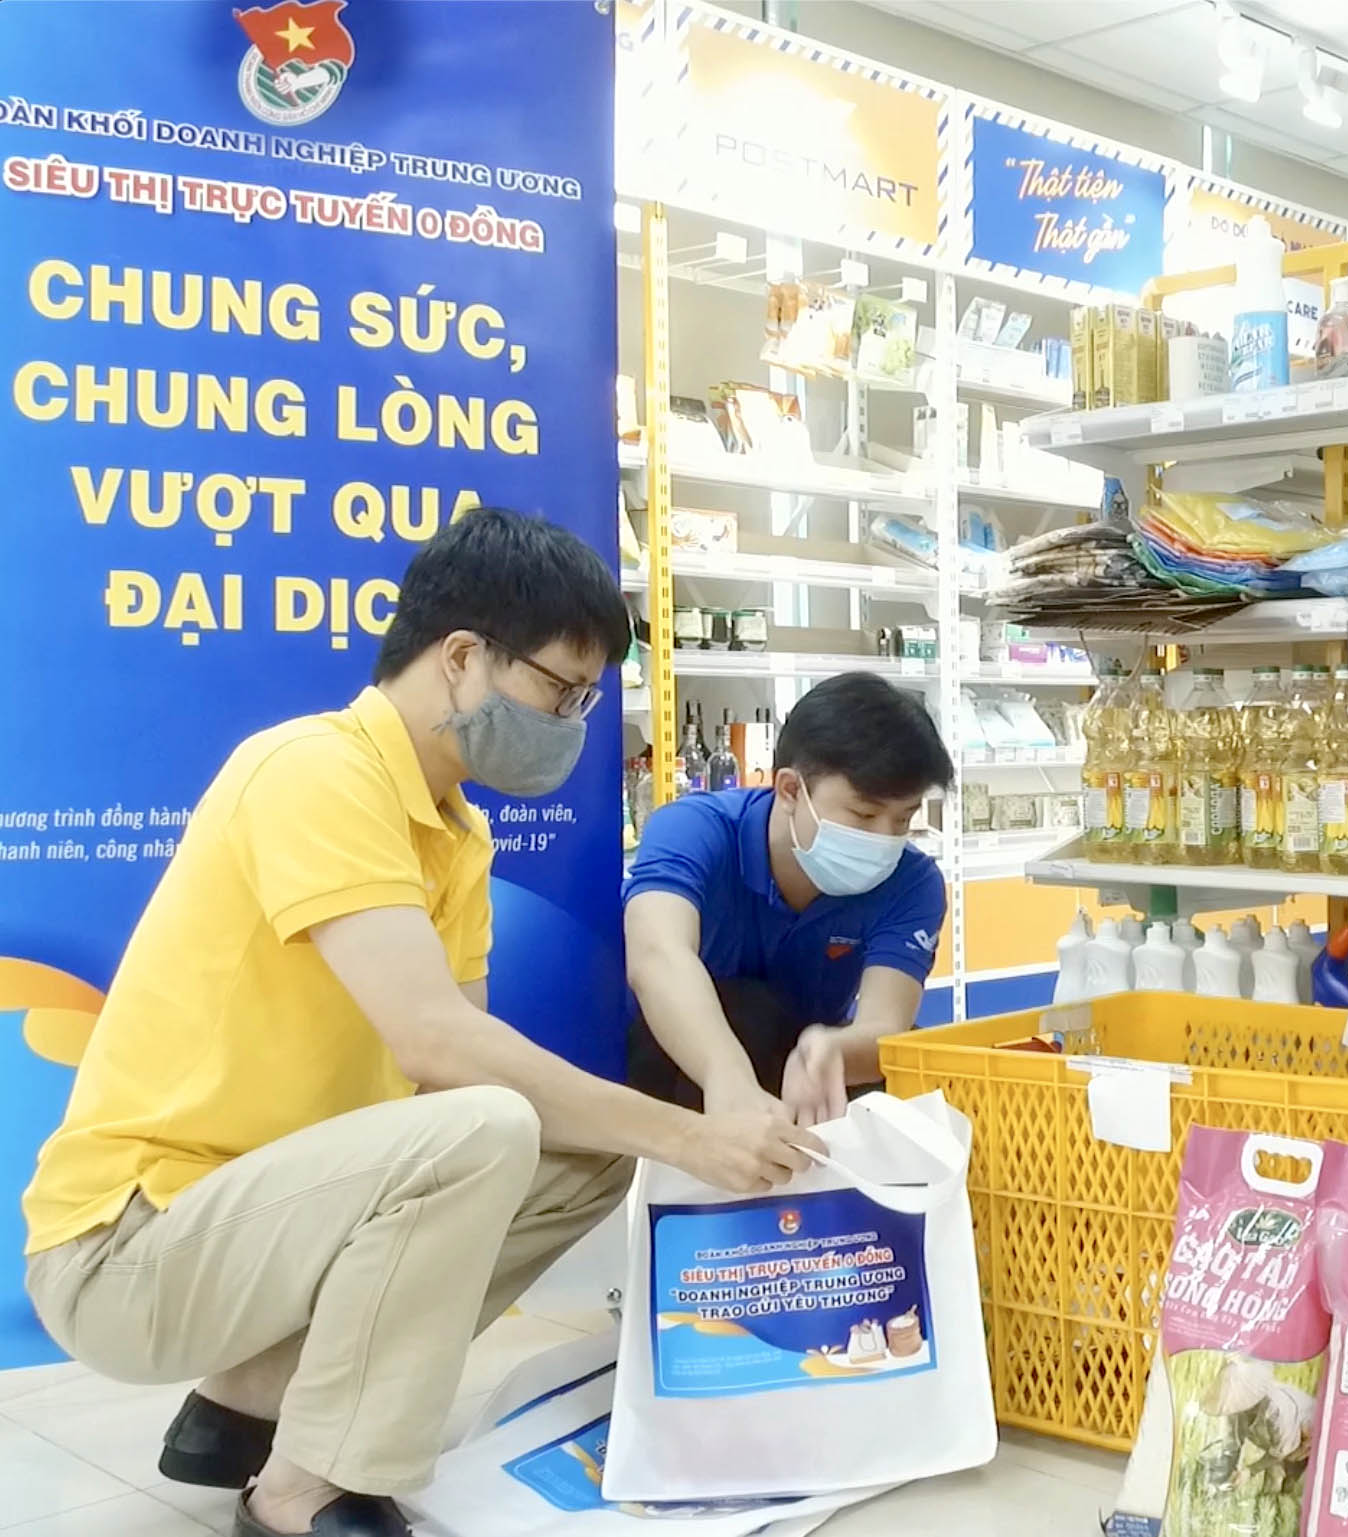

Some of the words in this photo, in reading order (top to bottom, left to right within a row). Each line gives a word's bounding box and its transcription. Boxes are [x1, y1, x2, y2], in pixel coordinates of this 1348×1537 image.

[0, 97, 56, 129] ÀN
[65, 107, 147, 140] KHỐI
[154, 122, 265, 155] DOANH
[273, 136, 386, 173] NGHIỆP
[393, 153, 490, 187] TRUNG
[497, 167, 582, 199] ƯƠNG
[715, 133, 918, 207] POSTMART
[4, 154, 98, 198] SIÊU
[105, 170, 174, 213] THỊ
[179, 179, 287, 223] TRỰC
[292, 190, 411, 236] TUYẾN
[445, 205, 544, 252] ĐỒNG
[1033, 211, 1088, 254] Thật
[29, 259, 320, 341] CHUNG
[349, 283, 526, 373] SỨC,
[13, 361, 306, 437] CHUNG
[337, 375, 539, 455] LÒNG
[71, 466, 306, 547] VƯỢT
[105, 569, 243, 646] ĐẠI
[275, 576, 401, 650] DỊC
[54, 806, 95, 827] trình
[101, 802, 144, 831] đồng
[500, 803, 537, 823] đoàn
[542, 803, 577, 825] viên,
[47, 839, 90, 862] niên,
[96, 839, 138, 862] công
[681, 1267, 715, 1284] SIÊU
[716, 1267, 744, 1284] THỊ
[747, 1261, 791, 1281] TRỰC
[792, 1251, 844, 1274] TUYẾN
[856, 1245, 895, 1265] ĐỒNG
[736, 1279, 801, 1302] NGHIỆP
[802, 1272, 860, 1292] TRUNG
[862, 1266, 906, 1286] ƯƠNG
[699, 1303, 746, 1321] TRAO
[747, 1295, 782, 1317] GỬI
[783, 1295, 817, 1313] YÊU
